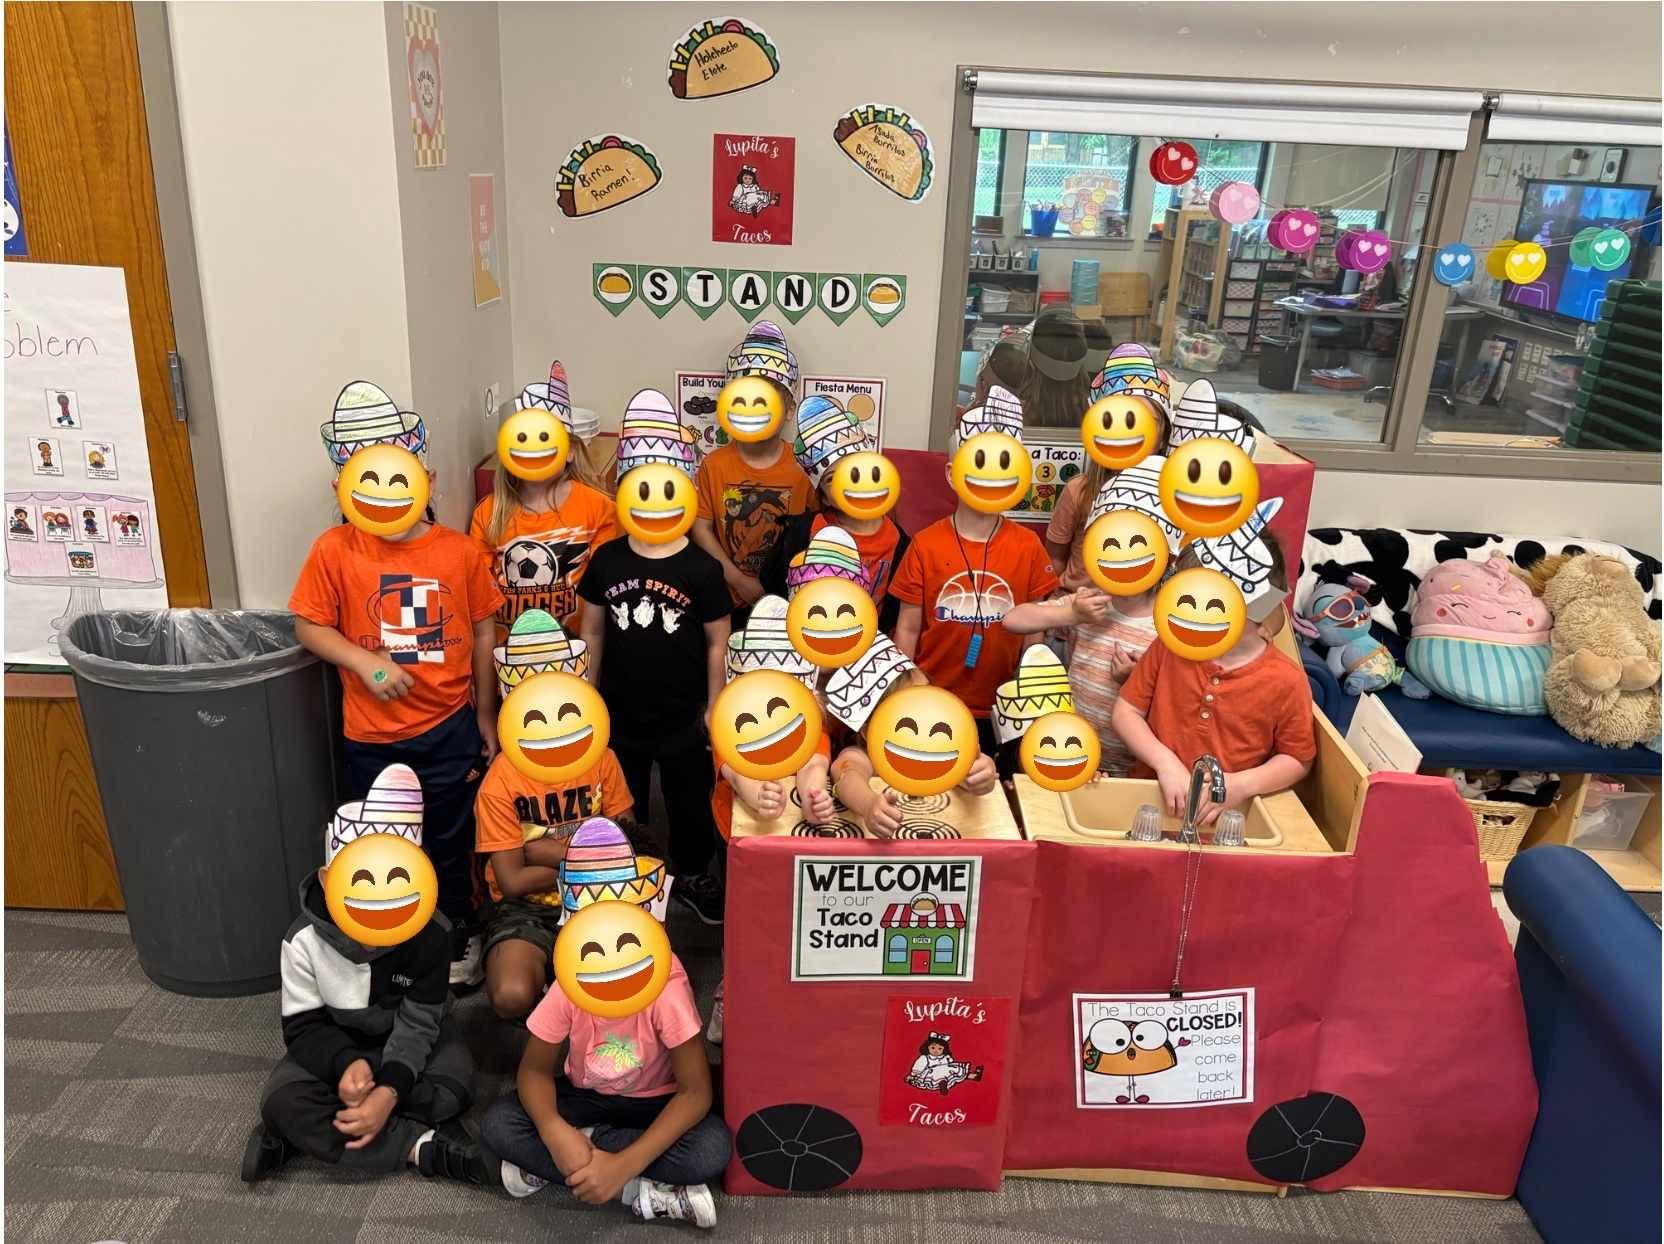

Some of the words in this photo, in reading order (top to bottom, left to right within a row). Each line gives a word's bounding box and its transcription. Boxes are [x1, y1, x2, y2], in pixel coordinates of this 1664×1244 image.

[702, 63, 727, 81] Elote
[578, 164, 614, 187] Birria
[591, 169, 635, 200] Ramen!
[732, 223, 772, 244] Tacos
[649, 272, 850, 308] STAND
[682, 377, 704, 387] Build
[707, 378, 726, 388] You
[815, 382, 844, 392] Fiesta
[846, 383, 872, 394] Menu
[1031, 449, 1041, 459] a
[1044, 447, 1081, 460] Taco:
[1042, 465, 1050, 478] 3
[645, 579, 691, 607] SPIRIT
[936, 607, 1006, 629] Champi
[513, 785, 592, 825] BLAZE
[806, 864, 966, 892] WELCOME
[822, 894, 837, 907] to
[844, 895, 874, 907] our
[817, 908, 873, 926] Taco
[809, 929, 879, 948] Stand
[1088, 1002, 1120, 1017] The
[1126, 1002, 1165, 1017] Taco
[1172, 1001, 1219, 1016] Stand
[1225, 999, 1237, 1012] is
[1166, 1012, 1242, 1032] CLOSED!
[1190, 1033, 1241, 1047] Please
[1195, 1054, 1237, 1066] come
[1198, 1070, 1233, 1084] back
[1196, 1087, 1236, 1101] later!
[908, 1103, 967, 1126] Tacos
